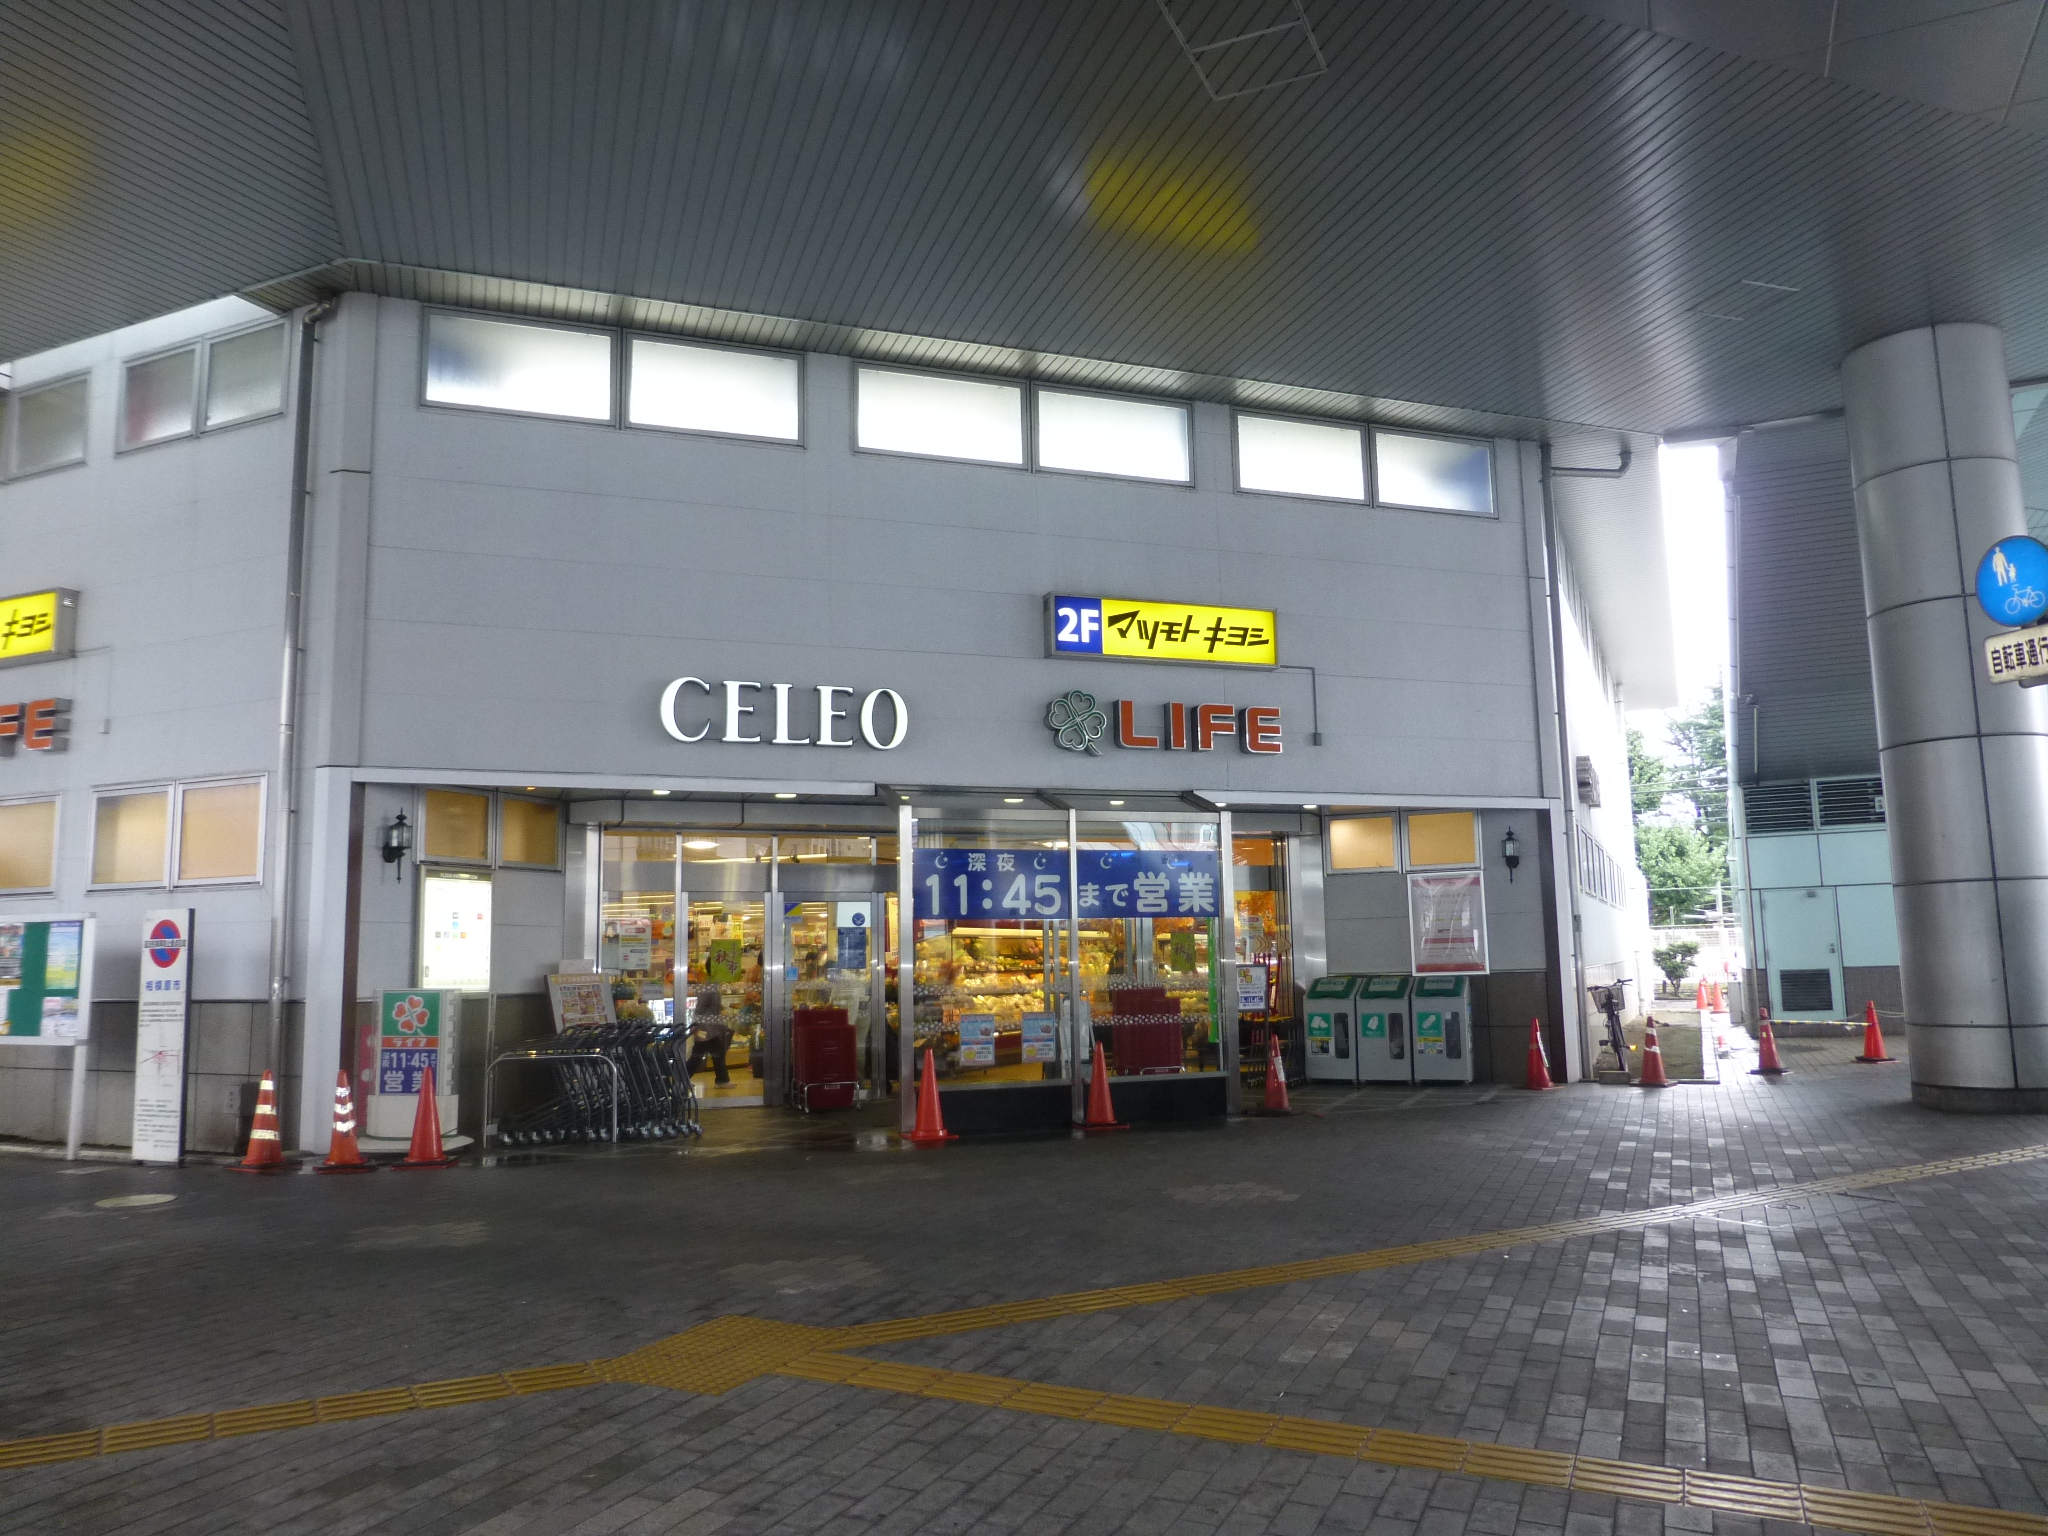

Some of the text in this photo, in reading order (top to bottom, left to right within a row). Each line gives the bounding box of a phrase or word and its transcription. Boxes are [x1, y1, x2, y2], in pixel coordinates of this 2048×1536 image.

[1056, 605, 1272, 655] 2F マツモトキヨシ
[658, 676, 909, 752] CELEO
[1114, 698, 1284, 755] LIFE
[967, 852, 1016, 872] 深夜
[925, 871, 1216, 916] 11:45 まで営業
[390, 1051, 429, 1068] 11:45
[392, 1037, 428, 1047] ライフ
